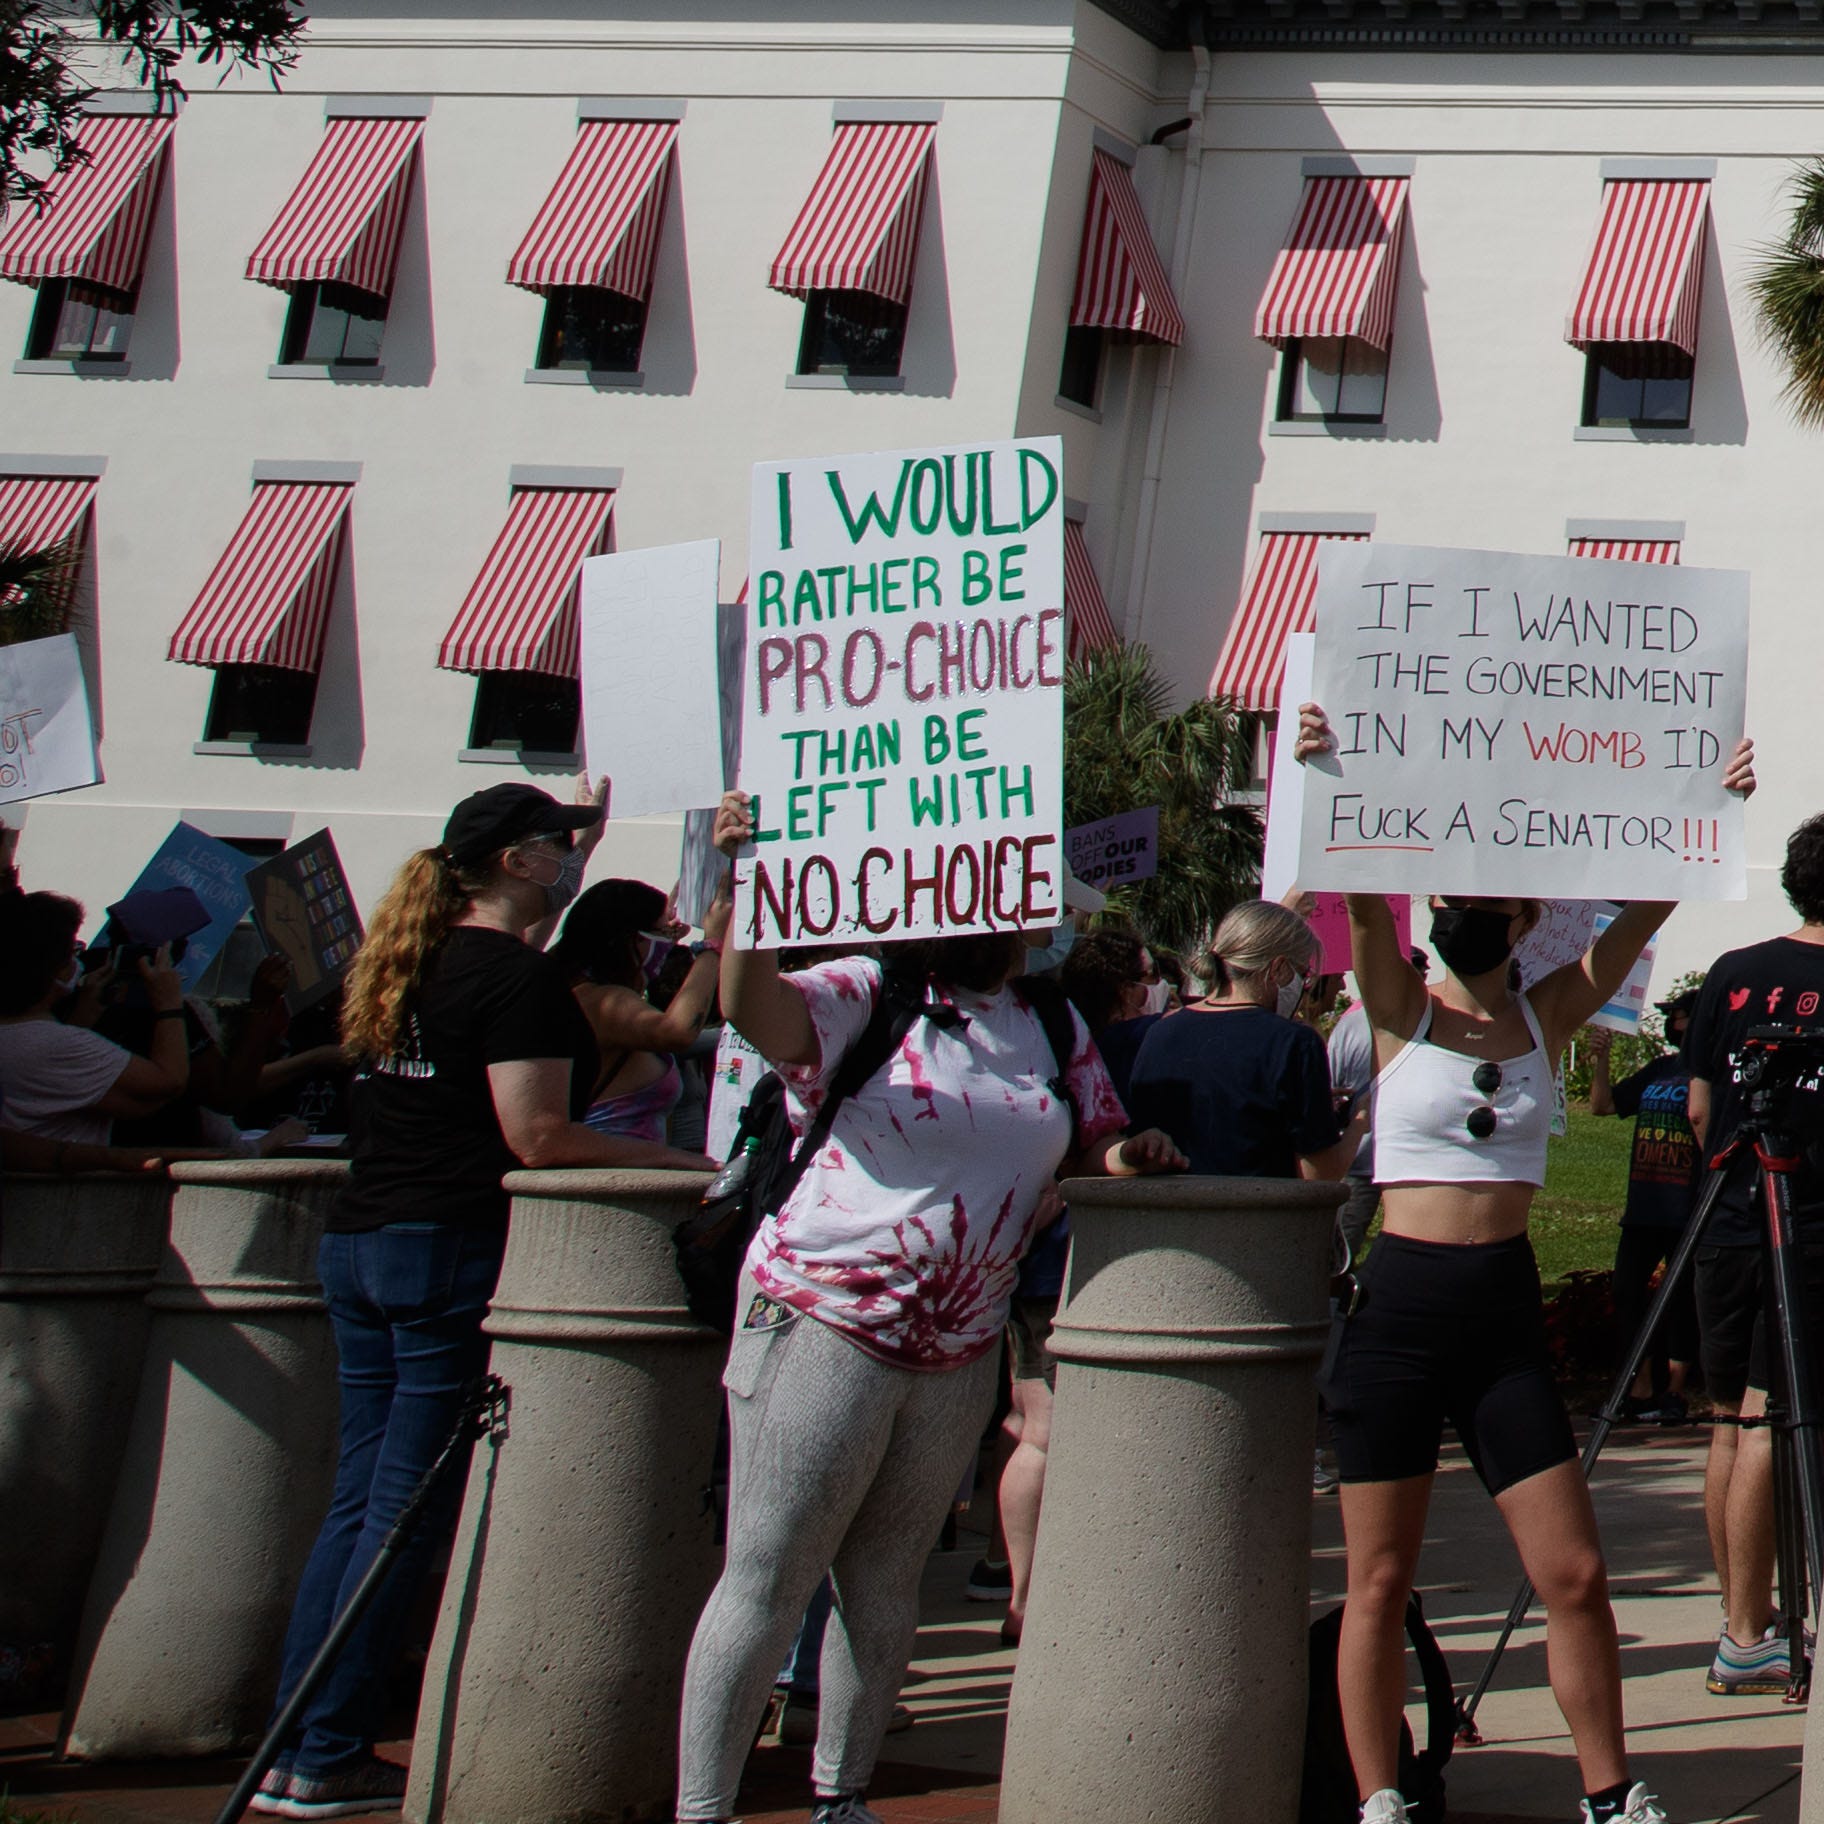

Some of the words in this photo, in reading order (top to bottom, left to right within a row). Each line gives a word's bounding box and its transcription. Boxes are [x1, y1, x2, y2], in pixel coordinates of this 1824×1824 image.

[777, 472, 791, 549] I
[827, 449, 1059, 544] WOULD
[759, 556, 942, 627] RATHER
[962, 545, 1028, 606] BE
[1358, 582, 1435, 633] IF
[1459, 588, 1491, 638] I
[1514, 591, 1698, 652] WANTED
[756, 608, 1064, 716] PRO-CHOICE
[1356, 651, 1451, 695] THE
[1466, 657, 1724, 708] GOVERNMENT
[0, 708, 43, 755] OT
[781, 719, 900, 779] THAN
[925, 709, 987, 765] BE
[1339, 711, 1407, 757] IN
[1441, 718, 1504, 760] MY
[1522, 722, 1645, 768] WOMB
[1664, 725, 1721, 769] I'D
[751, 778, 887, 843] LEFT
[910, 764, 1034, 828] WITH
[1329, 794, 1431, 842] FUCK
[1444, 801, 1475, 843] A
[1493, 798, 1721, 864] SENATOR!!!
[187, 845, 236, 885] LEGAL
[1072, 825, 1115, 852] BANS
[1072, 847, 1105, 870] OFF
[1105, 837, 1149, 858] OUR
[157, 855, 243, 911] ABORTIONS
[752, 854, 841, 946] NO
[852, 834, 1059, 934] CHOICE
[1074, 857, 1136, 882] ODIES
[1640, 1084, 1688, 1102] BLAC
[1635, 1142, 1693, 1169] OMEN'S
